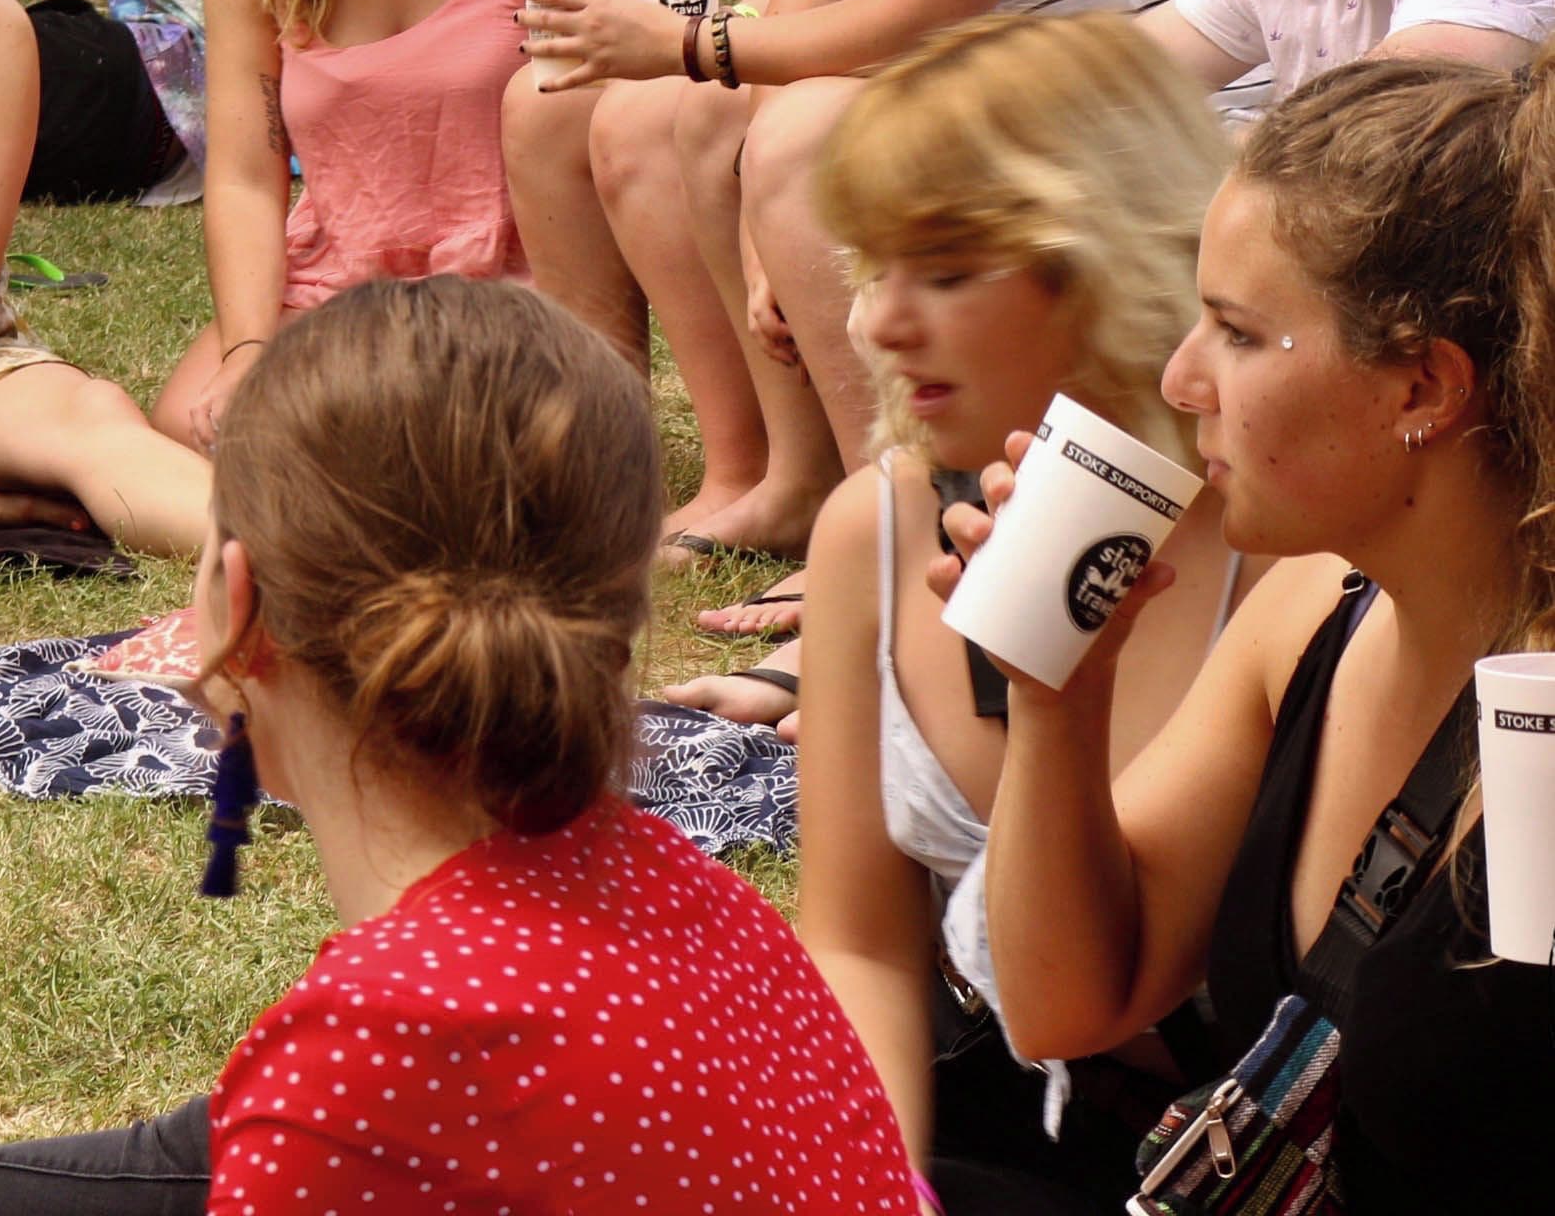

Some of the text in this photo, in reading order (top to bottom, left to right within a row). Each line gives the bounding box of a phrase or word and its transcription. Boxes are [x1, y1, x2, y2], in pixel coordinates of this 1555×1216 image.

[1066, 443, 1110, 478] STOKE
[1110, 471, 1169, 513] SUPPORTS
[1499, 712, 1545, 730] STOKE
